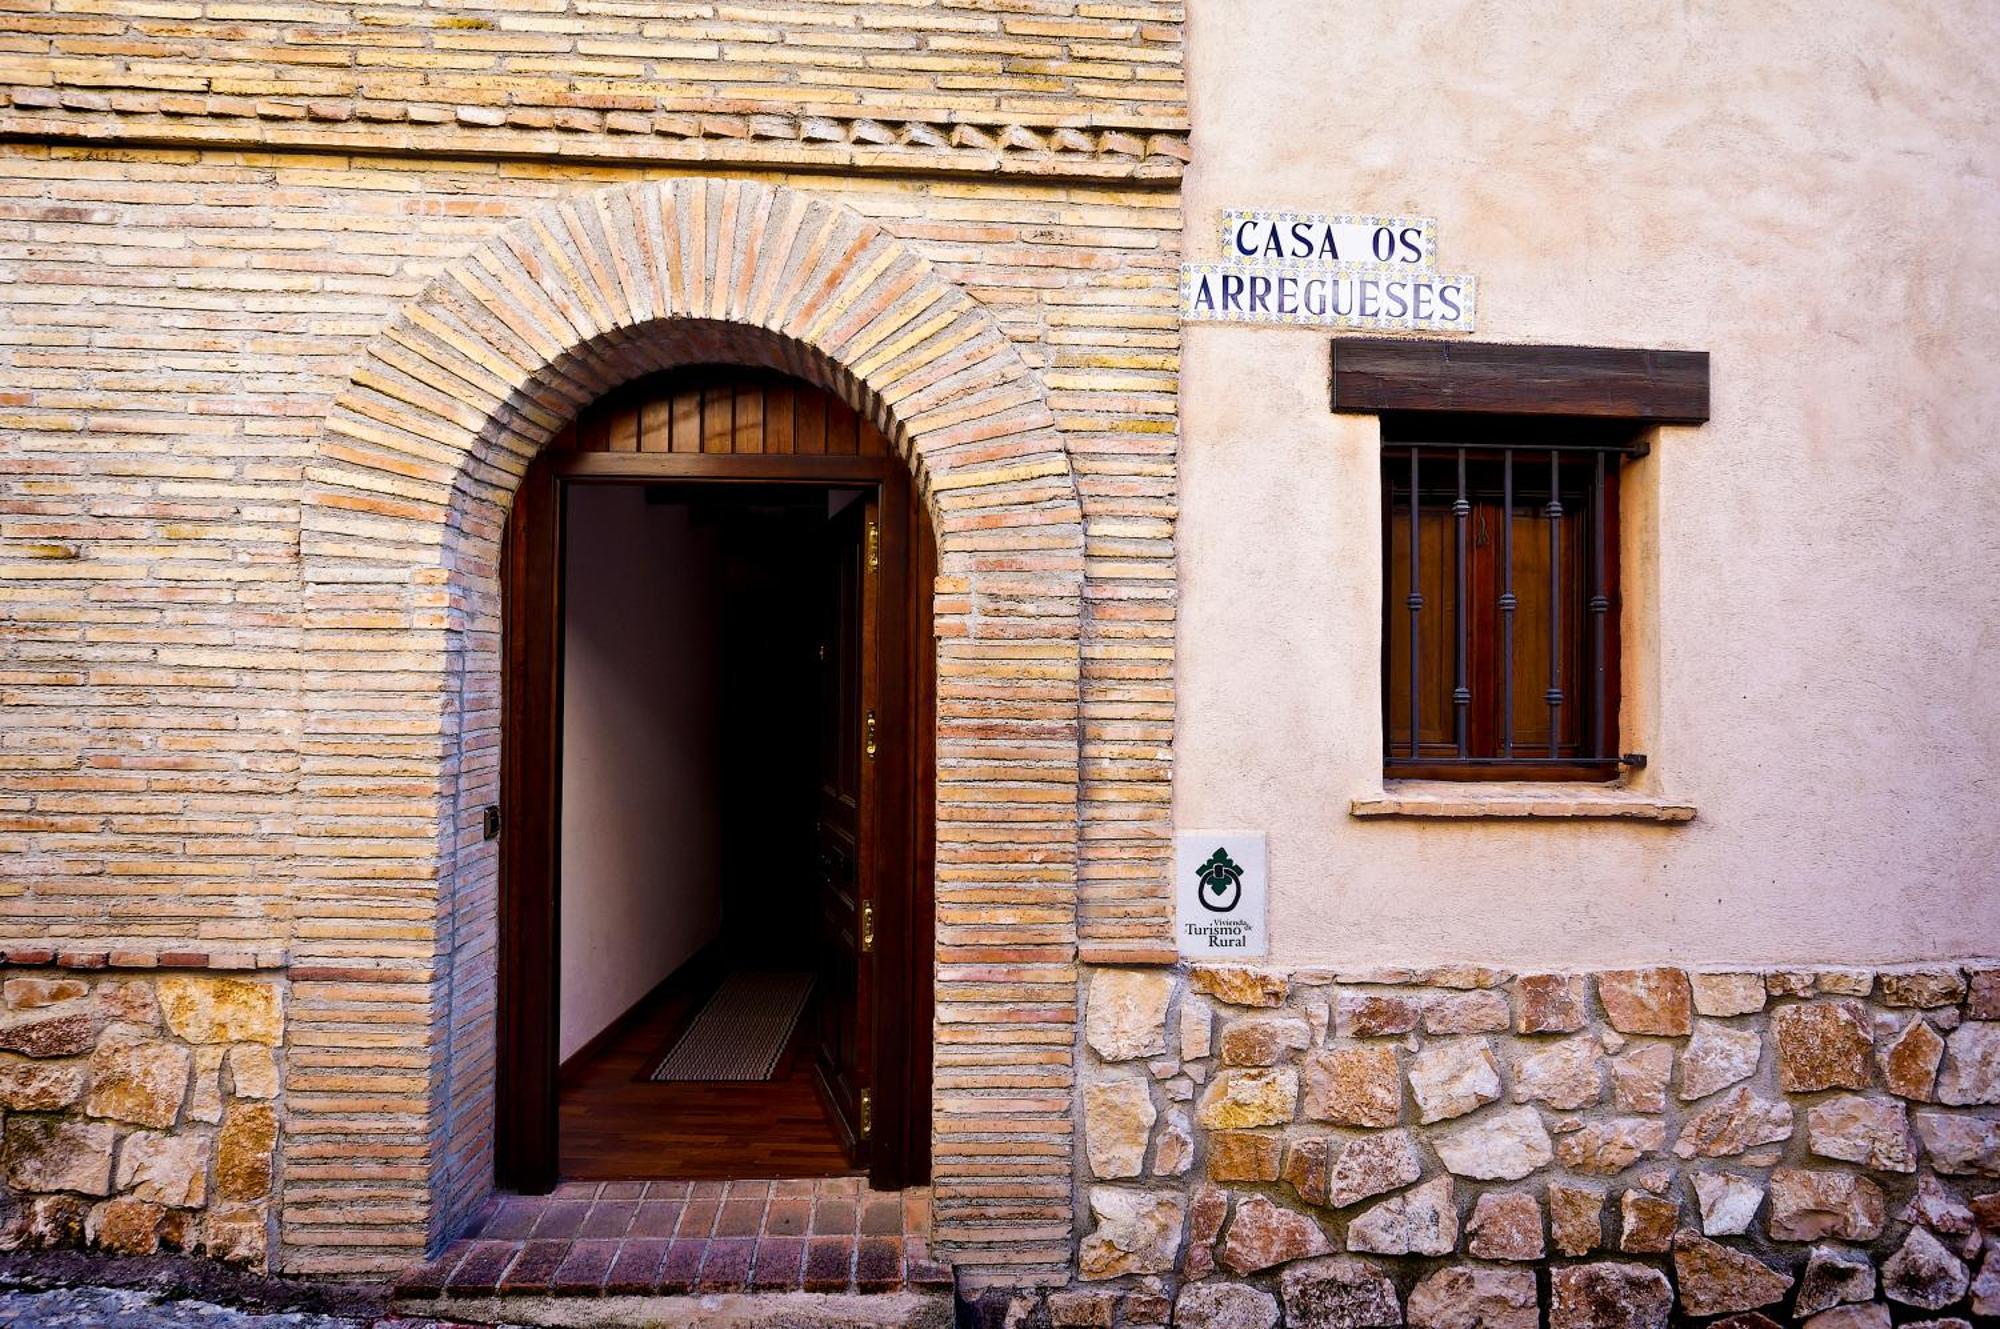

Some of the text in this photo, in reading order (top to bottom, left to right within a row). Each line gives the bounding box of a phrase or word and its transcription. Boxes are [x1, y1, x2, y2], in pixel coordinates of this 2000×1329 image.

[1236, 220, 1423, 264] CASA OS
[1194, 274, 1462, 322] ARREGUESES
[1185, 923, 1242, 935] Turismo
[1208, 935, 1246, 947] Rural
